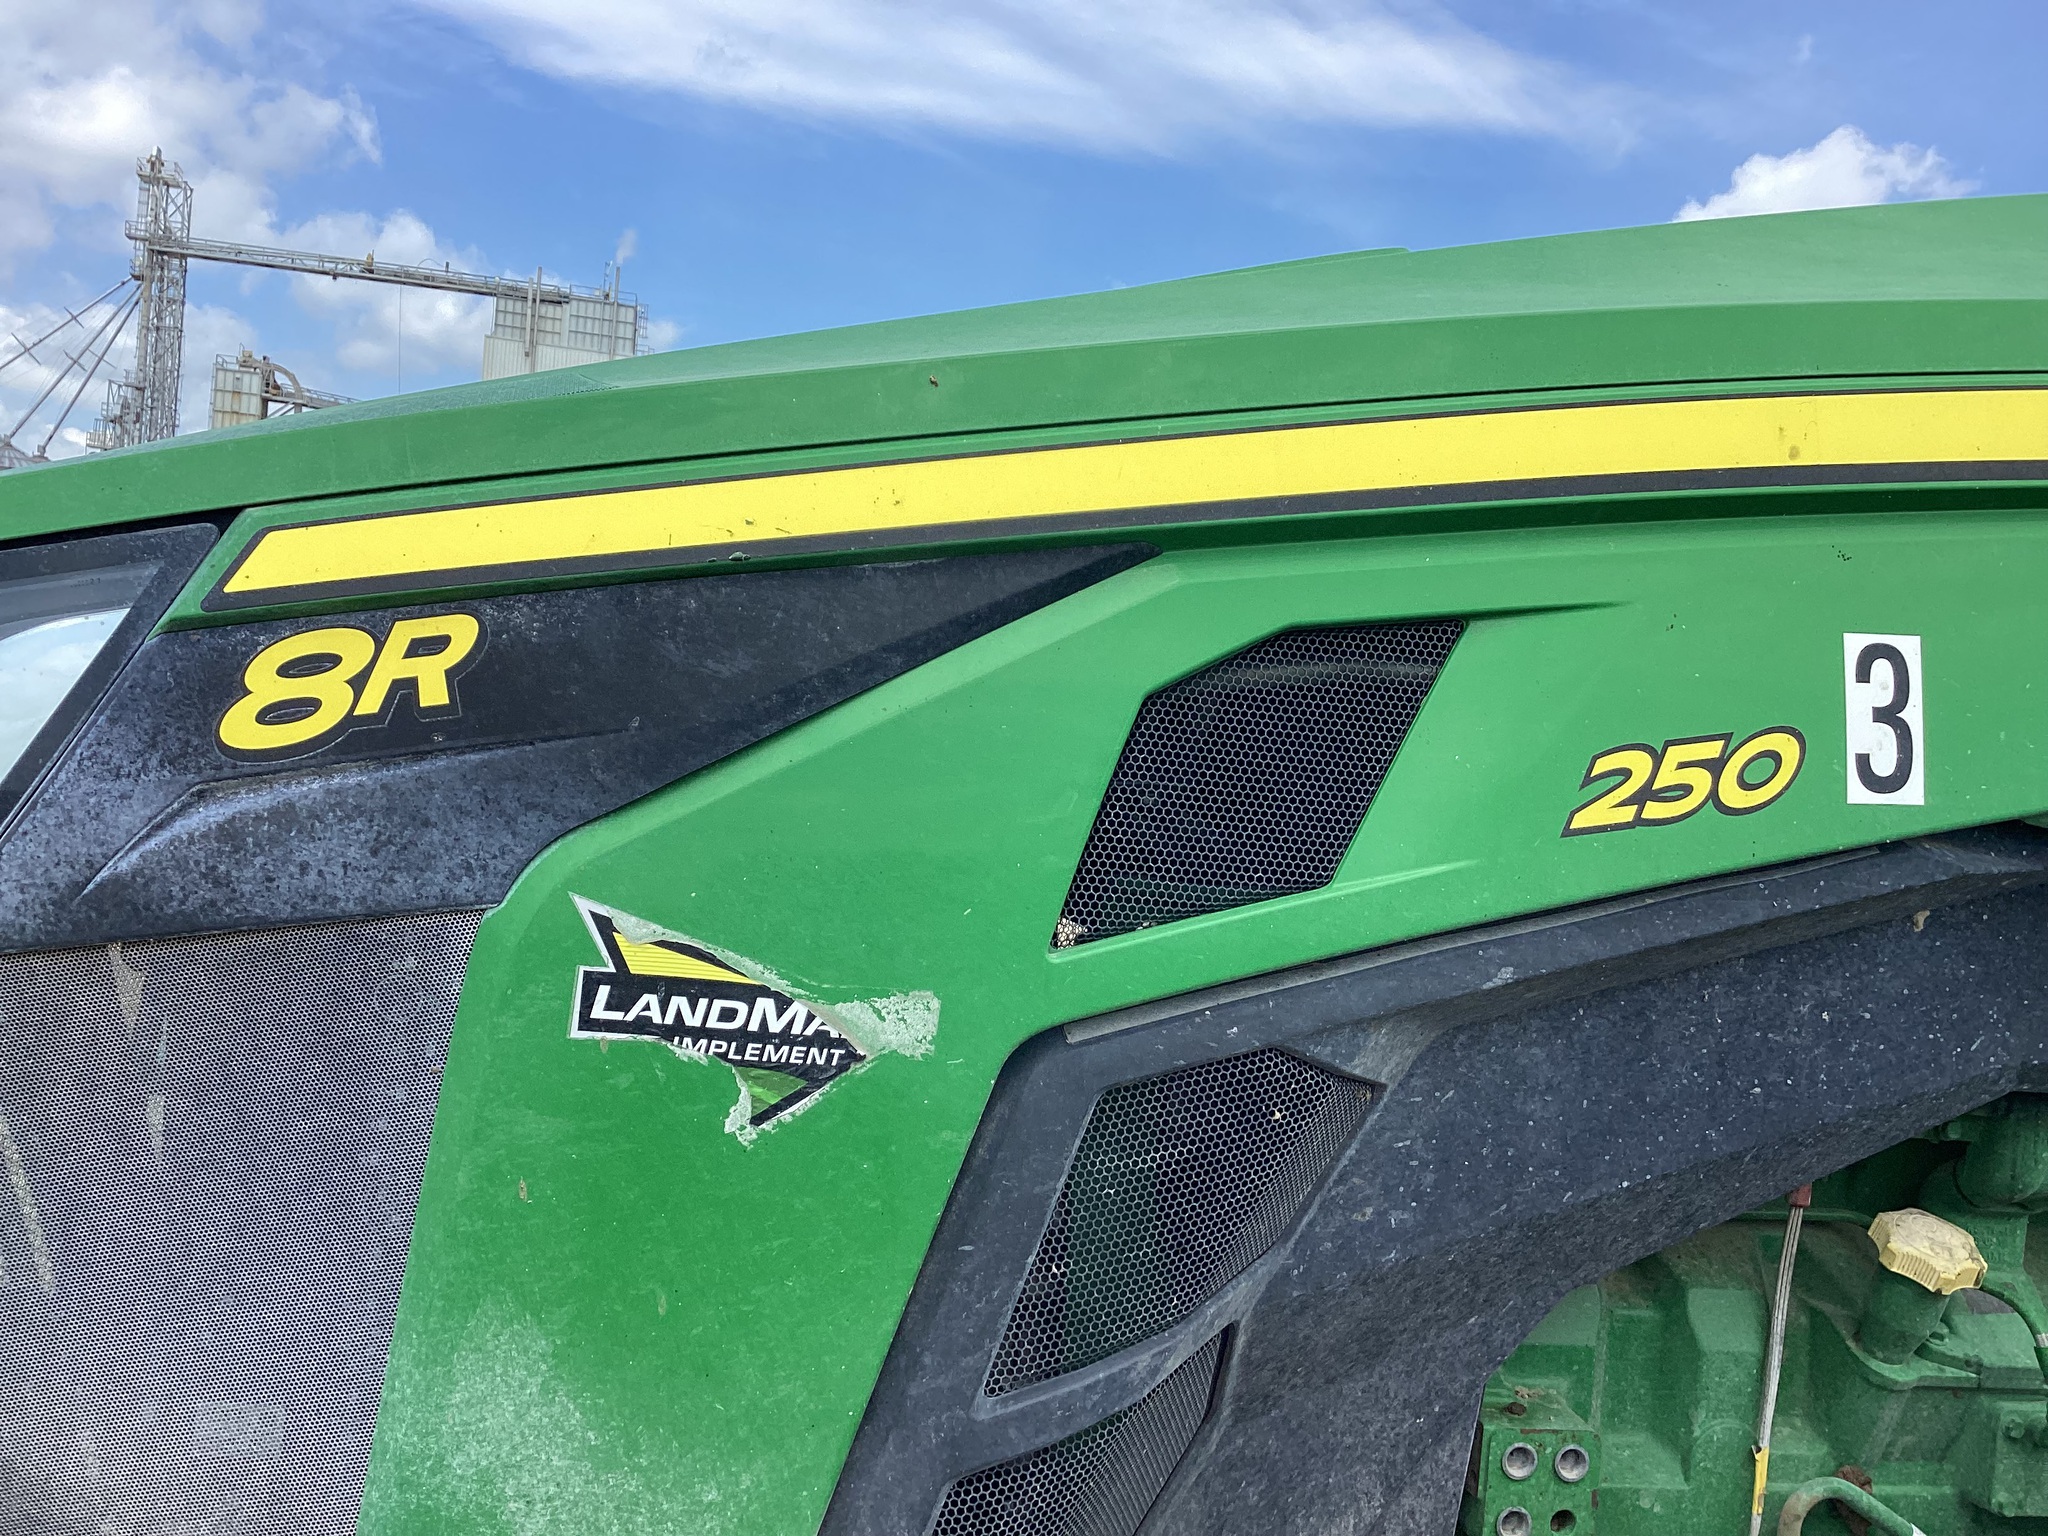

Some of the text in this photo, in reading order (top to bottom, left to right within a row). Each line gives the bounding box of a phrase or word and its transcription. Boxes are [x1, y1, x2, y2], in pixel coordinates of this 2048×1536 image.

[219, 614, 479, 749] 8R
[1855, 642, 1914, 794] 3
[1562, 727, 1805, 836] 250
[590, 985, 846, 1039] LANDMA
[673, 1036, 846, 1066] IMPLEMENT
